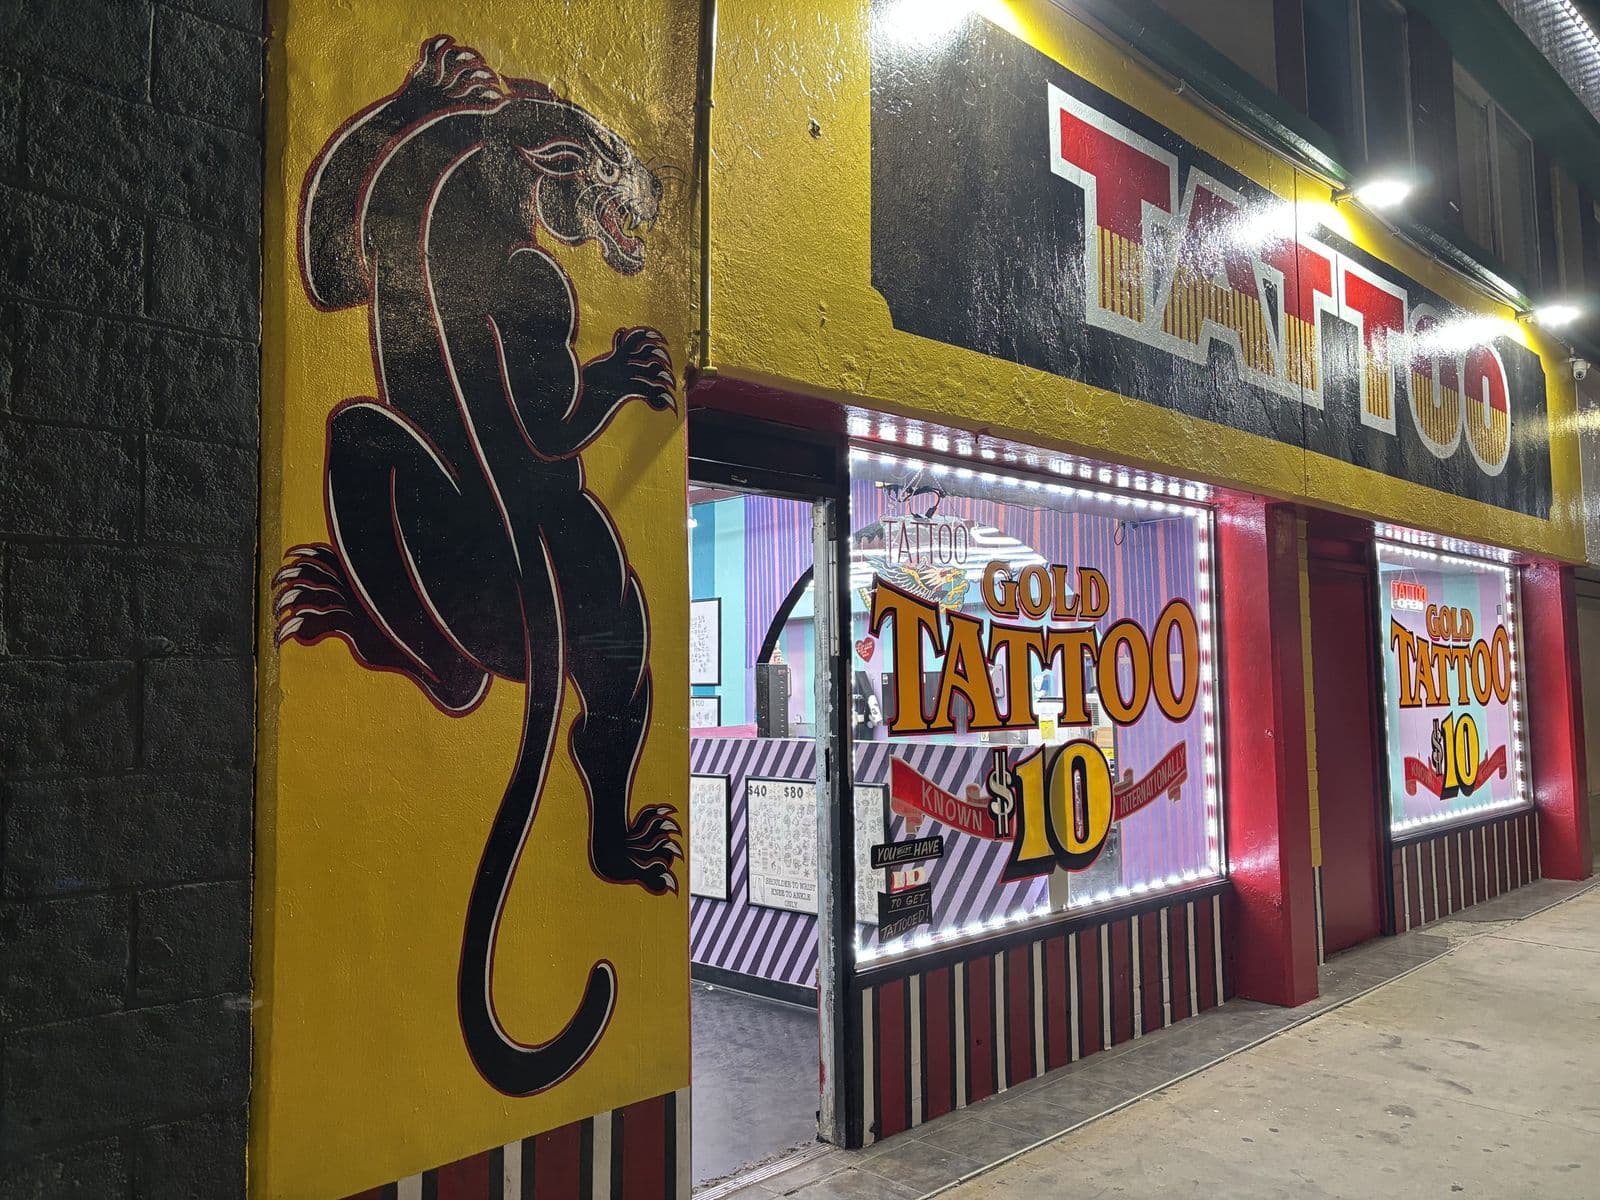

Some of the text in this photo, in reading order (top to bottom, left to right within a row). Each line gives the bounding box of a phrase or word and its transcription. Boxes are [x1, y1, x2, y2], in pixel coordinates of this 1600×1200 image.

[1048, 81, 1511, 477] TATTOO
[882, 520, 968, 565] TATTOO
[980, 560, 1110, 622] GOLD
[1425, 604, 1474, 642] GOLD
[868, 572, 1200, 738] TATTOO
[1391, 614, 1511, 706] TATTOO
[1120, 747, 1185, 815] INTERNATIONALLY
[1431, 711, 1480, 799] $10
[748, 784, 804, 799] $40 $80
[921, 781, 983, 832] KNOWN
[987, 739, 1113, 880] $10
[877, 847, 897, 863] YOU
[913, 839, 940, 857] HAVE
[892, 892, 926, 910] TO GET
